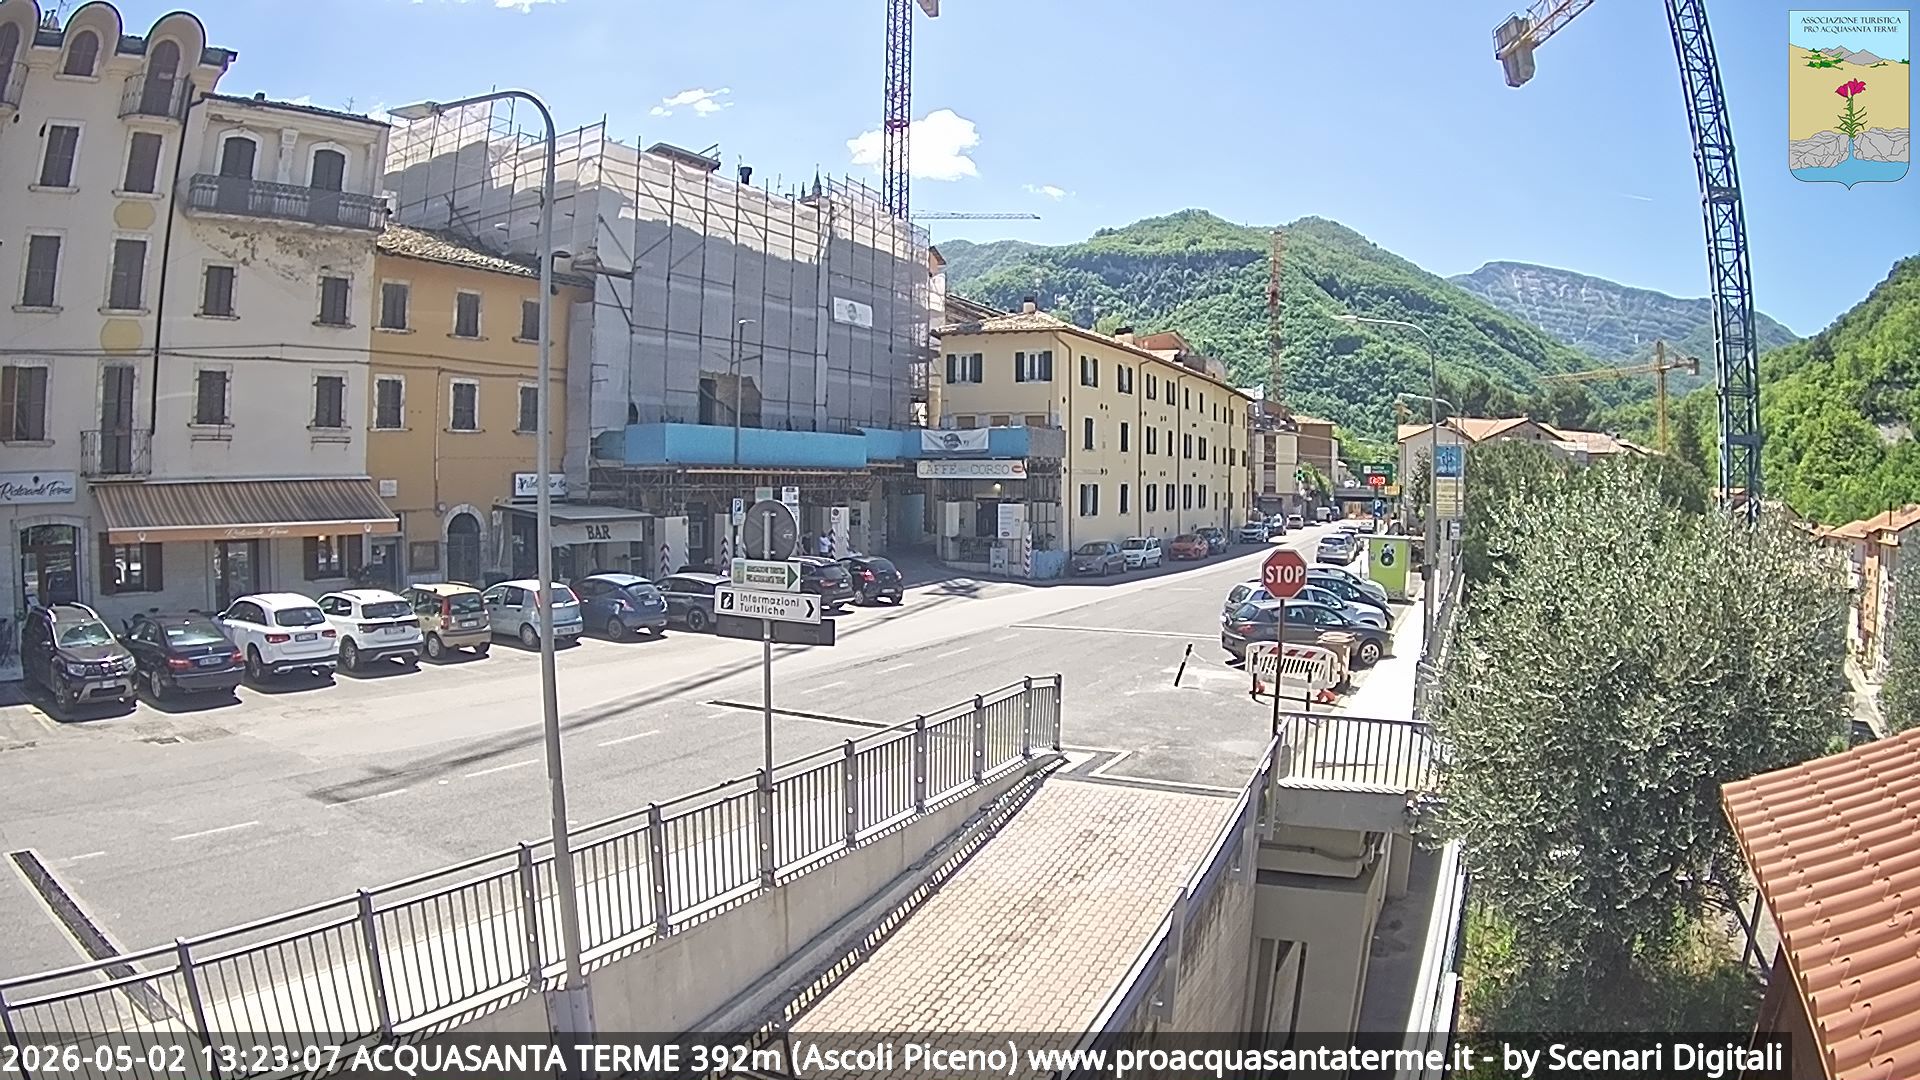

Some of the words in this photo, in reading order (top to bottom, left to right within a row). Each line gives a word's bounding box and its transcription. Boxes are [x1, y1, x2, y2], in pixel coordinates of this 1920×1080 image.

[970, 464, 1010, 475] CORSO
[585, 525, 611, 540] BAR
[1265, 565, 1304, 584] STOP
[740, 593, 800, 607] Informazioni
[740, 603, 785, 616] Turistiche
